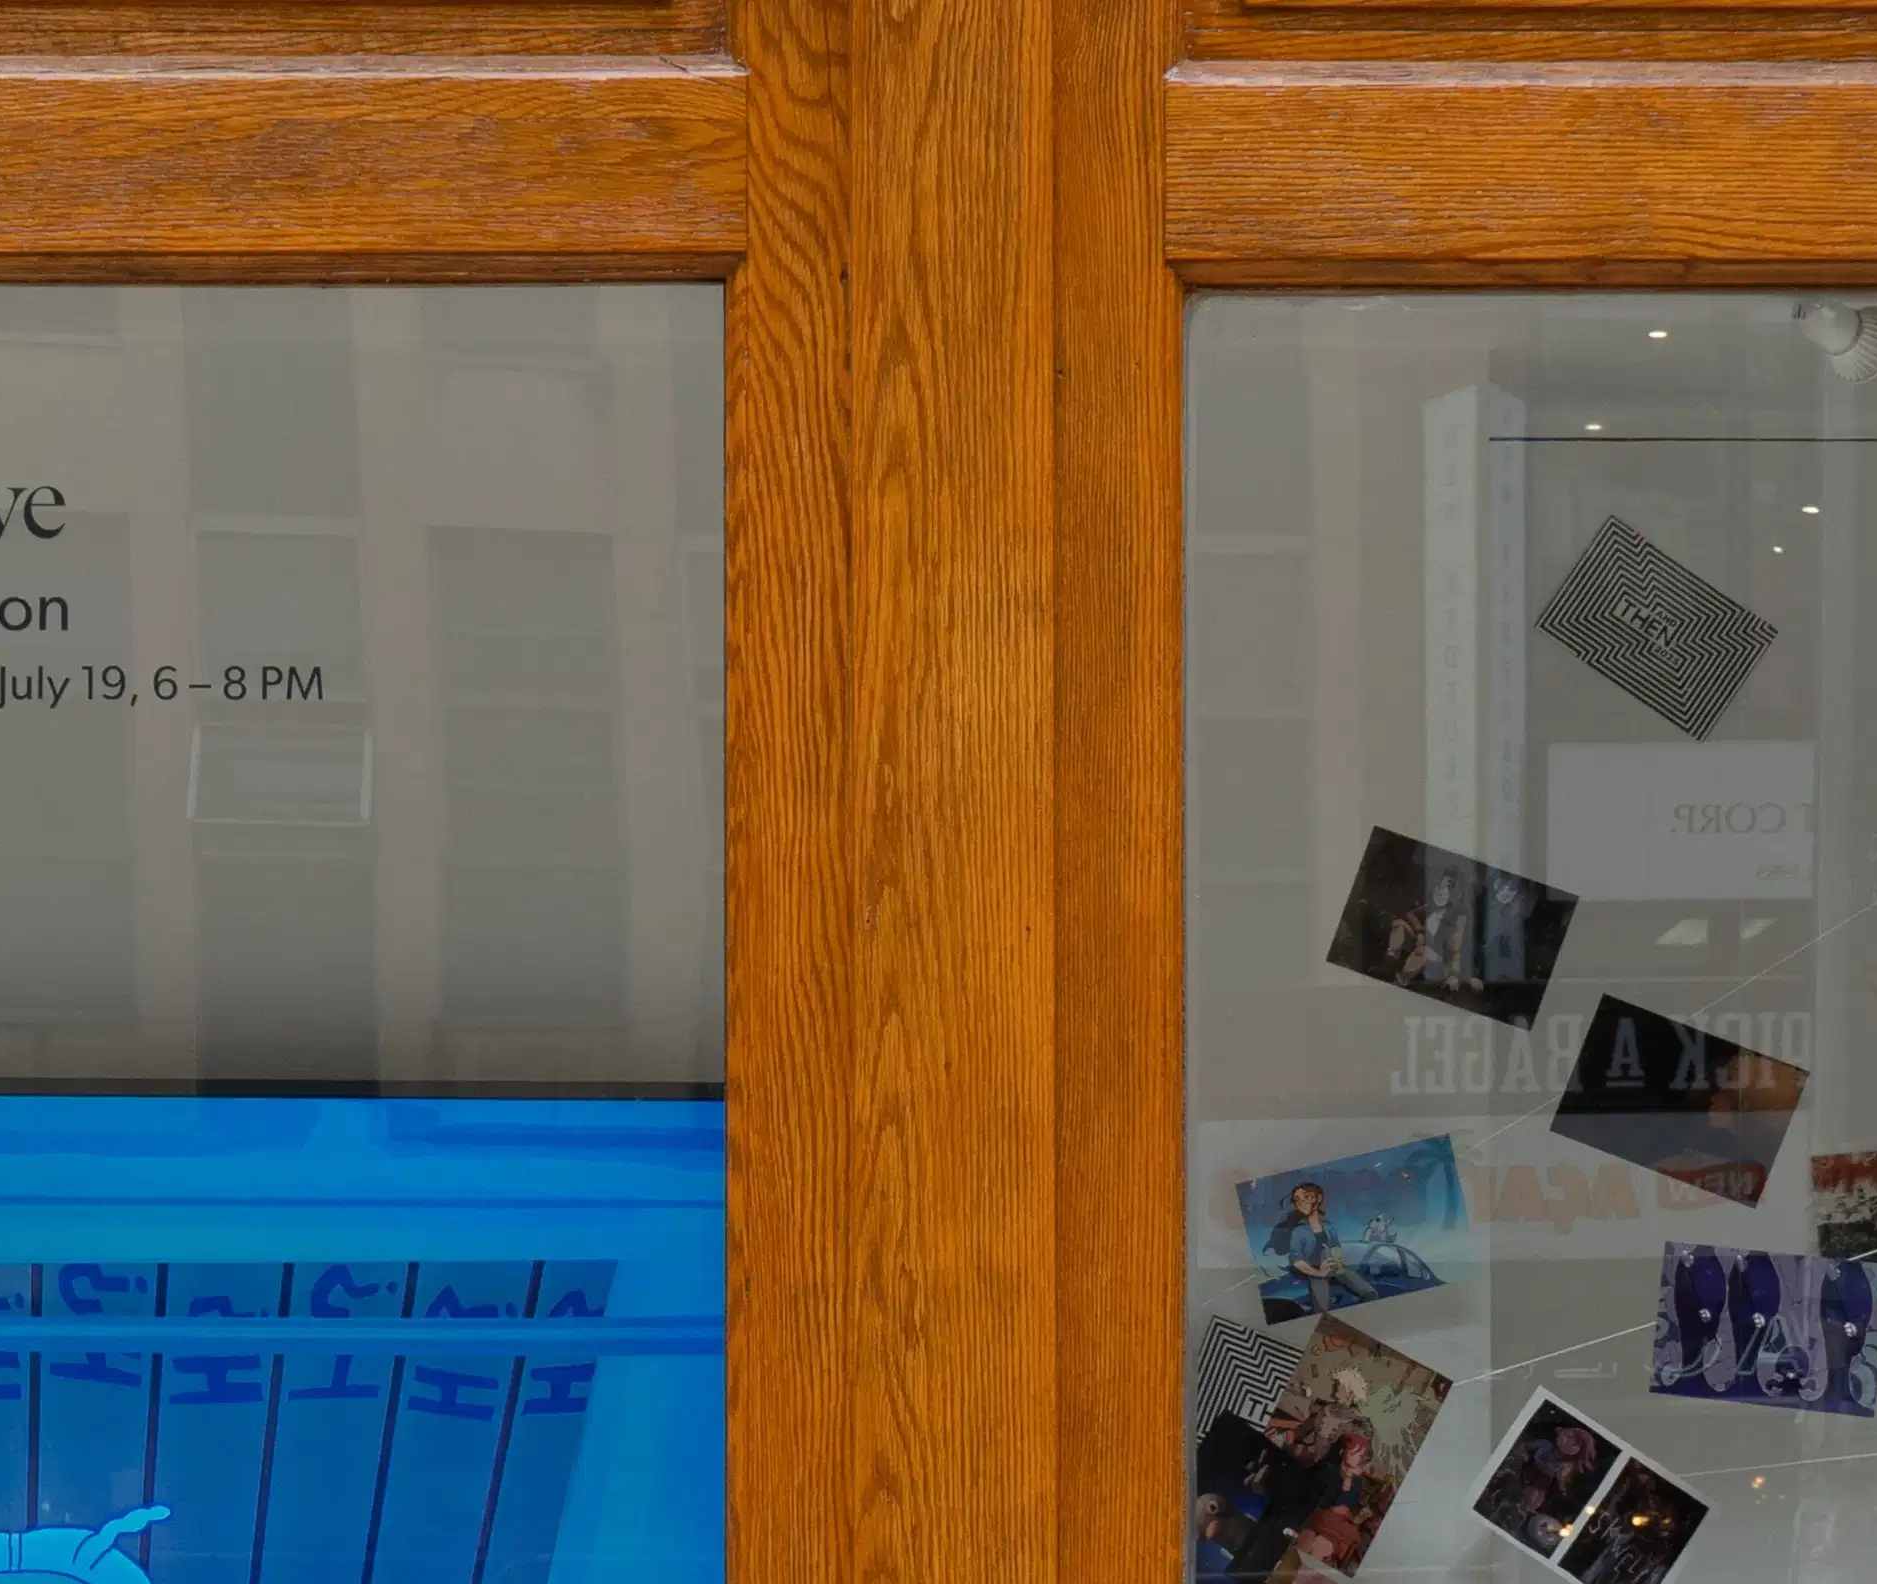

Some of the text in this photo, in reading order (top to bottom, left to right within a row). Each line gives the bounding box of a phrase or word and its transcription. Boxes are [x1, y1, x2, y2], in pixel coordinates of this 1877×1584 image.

[1621, 598, 1677, 647] THEN
[81, 665, 139, 708] 19,
[153, 665, 179, 701] 6
[223, 664, 247, 701] 8
[261, 665, 324, 701] PM
